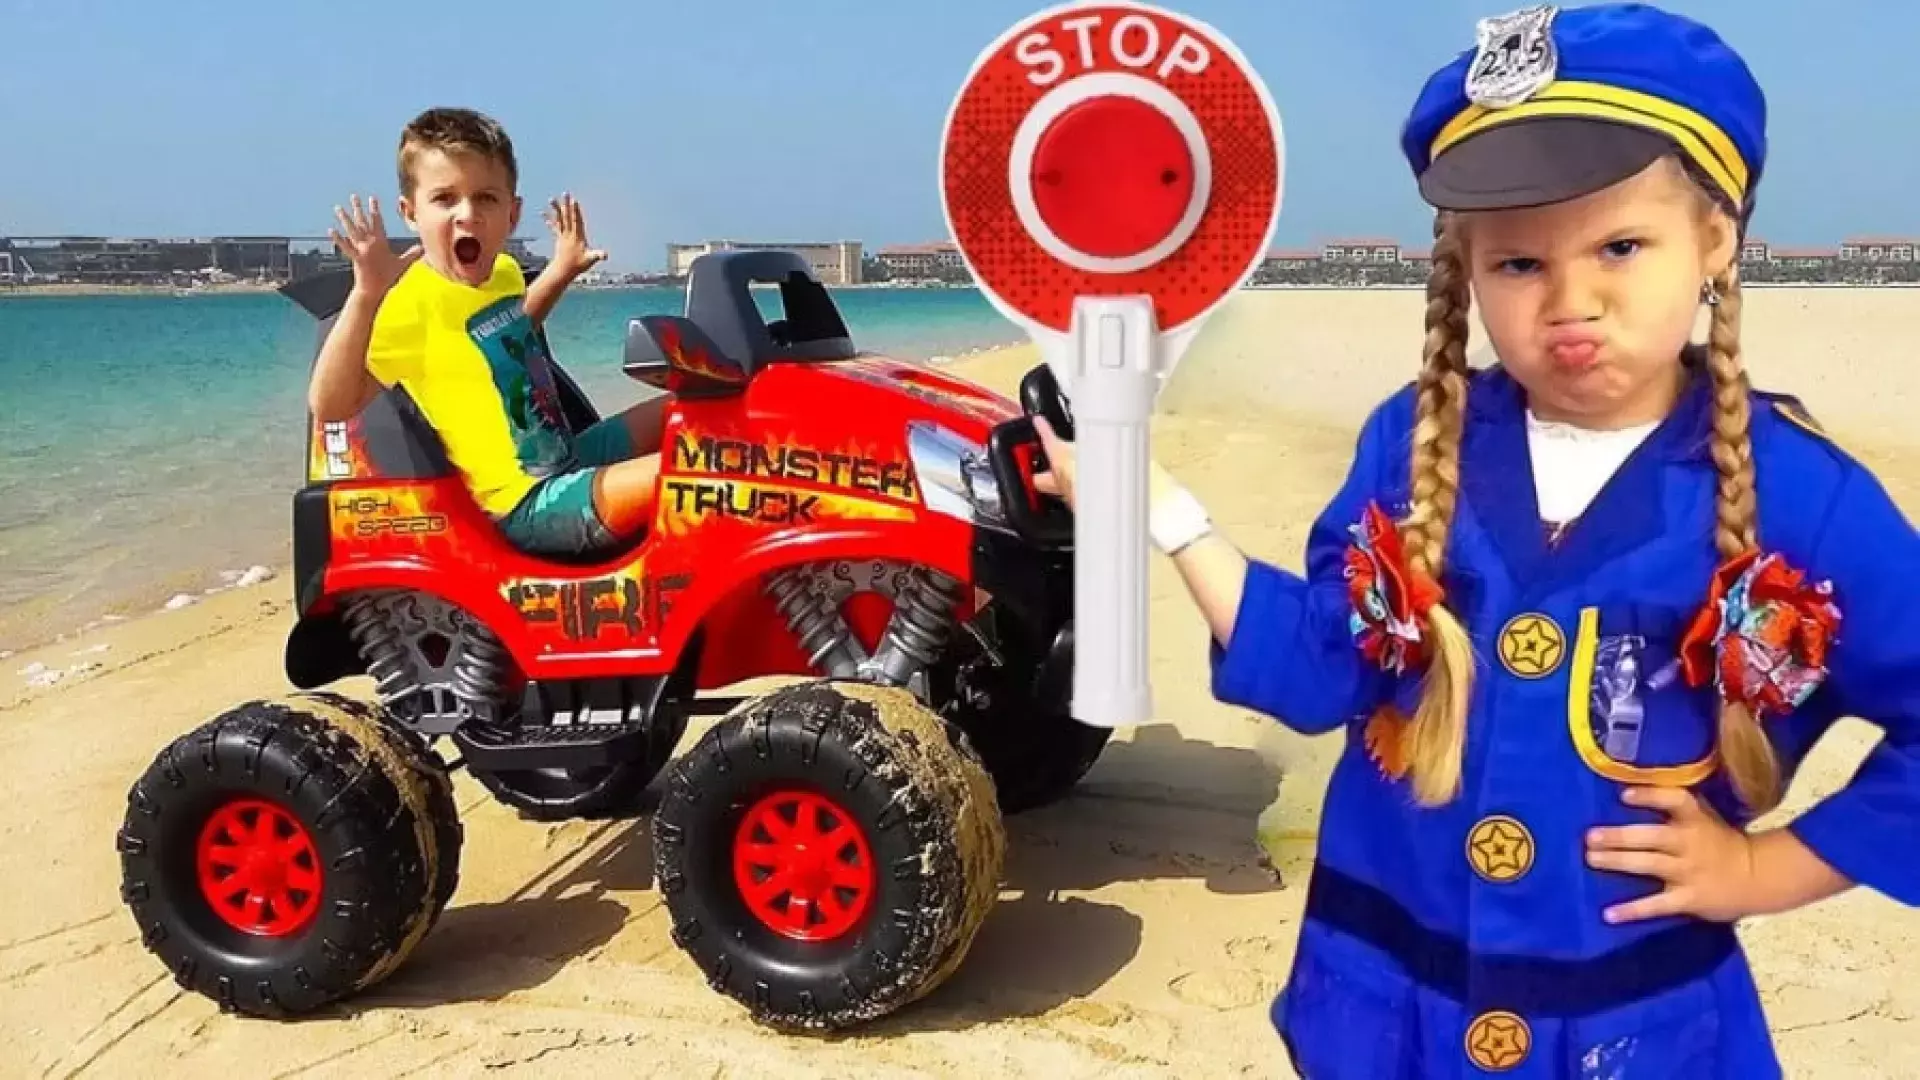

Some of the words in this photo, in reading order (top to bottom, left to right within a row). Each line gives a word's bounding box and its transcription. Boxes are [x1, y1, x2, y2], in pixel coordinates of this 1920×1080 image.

[1015, 15, 1211, 85] STOP
[674, 434, 914, 498] MONSTER
[335, 496, 391, 515] HIGH
[666, 481, 821, 524] TRUCK
[357, 516, 448, 537] SPEED
